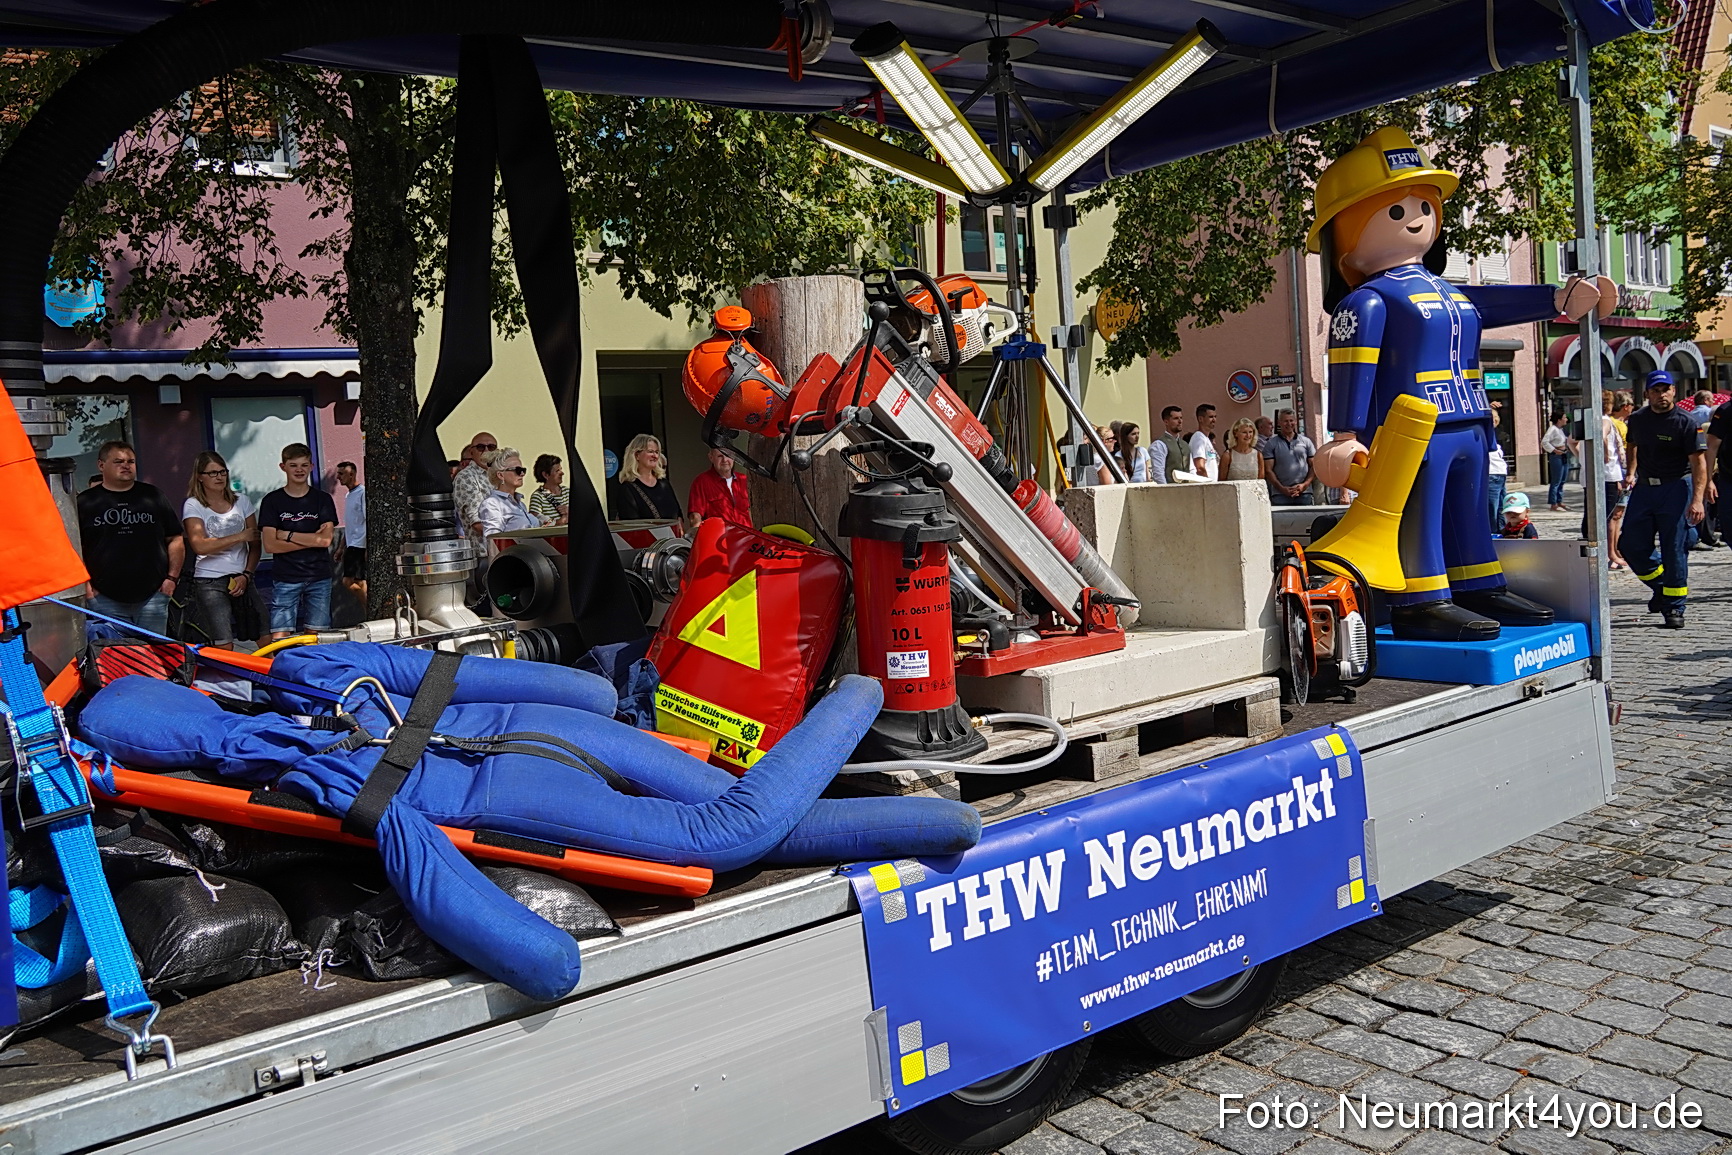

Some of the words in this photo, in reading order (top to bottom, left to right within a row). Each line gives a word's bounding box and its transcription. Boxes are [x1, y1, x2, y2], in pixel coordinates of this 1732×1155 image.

[1388, 152, 1419, 165] THW
[1106, 309, 1125, 319] NEU
[94, 508, 155, 527] s.Oliver
[913, 575, 949, 589] WÜRTH
[891, 608, 908, 616] Art.
[910, 606, 931, 615] 0651
[934, 603, 945, 612] 150
[892, 628, 910, 641] 10
[914, 628, 922, 640] L
[1514, 633, 1576, 676] playmobil
[661, 699, 674, 710] OV
[674, 704, 720, 729] Neumarkt
[700, 704, 742, 727] Hilfswerk
[915, 848, 1066, 952] THW
[1083, 768, 1337, 899] Neumarkt
[1036, 868, 1268, 983] #TEAM_TECHNIK_EHRENAMT
[1080, 934, 1246, 1009] www.thw-neumarkt.de
